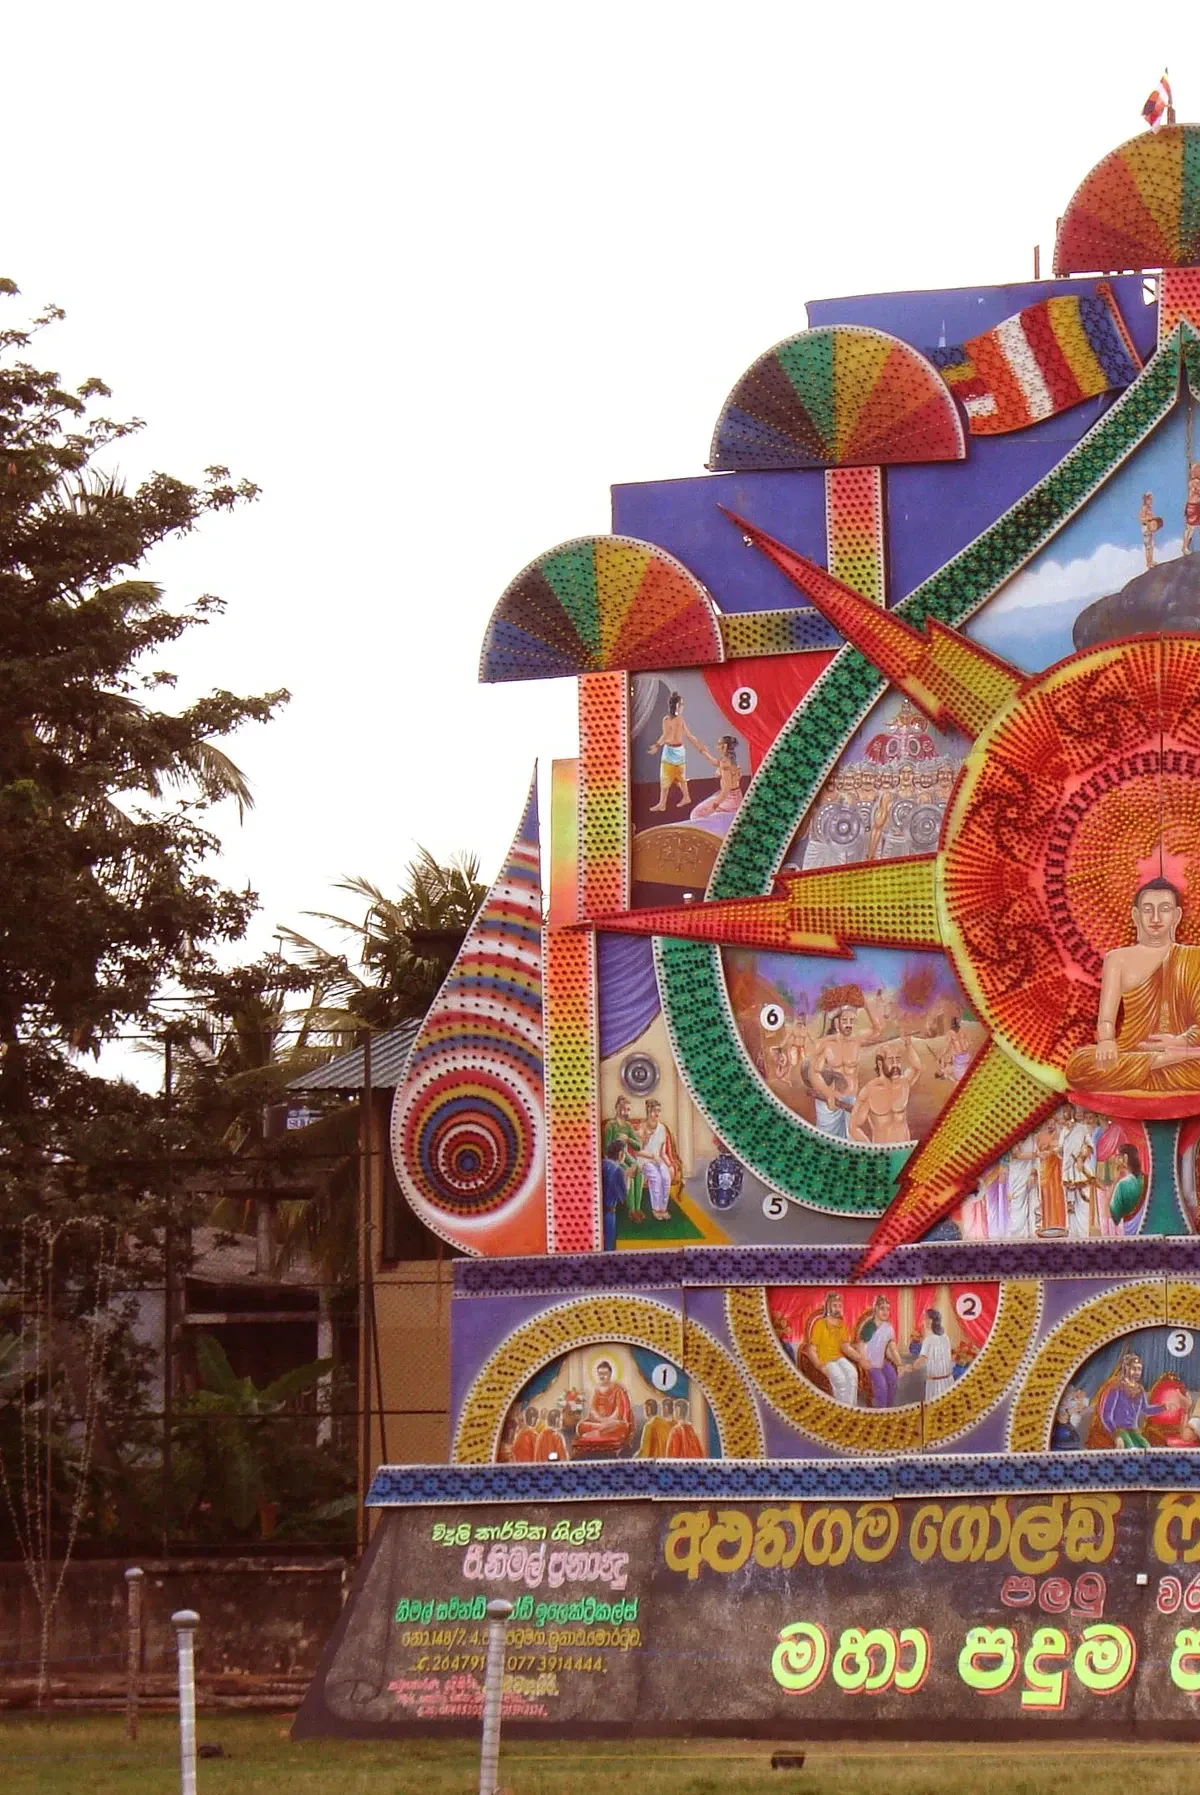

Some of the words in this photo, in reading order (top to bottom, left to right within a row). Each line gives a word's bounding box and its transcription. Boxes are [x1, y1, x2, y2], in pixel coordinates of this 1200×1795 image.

[737, 692, 751, 710] 8
[766, 1009, 779, 1026] 6
[769, 1198, 783, 1215] 5
[962, 1298, 977, 1317] 2
[1174, 1335, 1187, 1353] 3
[660, 1368, 668, 1386] 1
[771, 1622, 932, 1694] මහා
[957, 1622, 1137, 1710] පදුම
